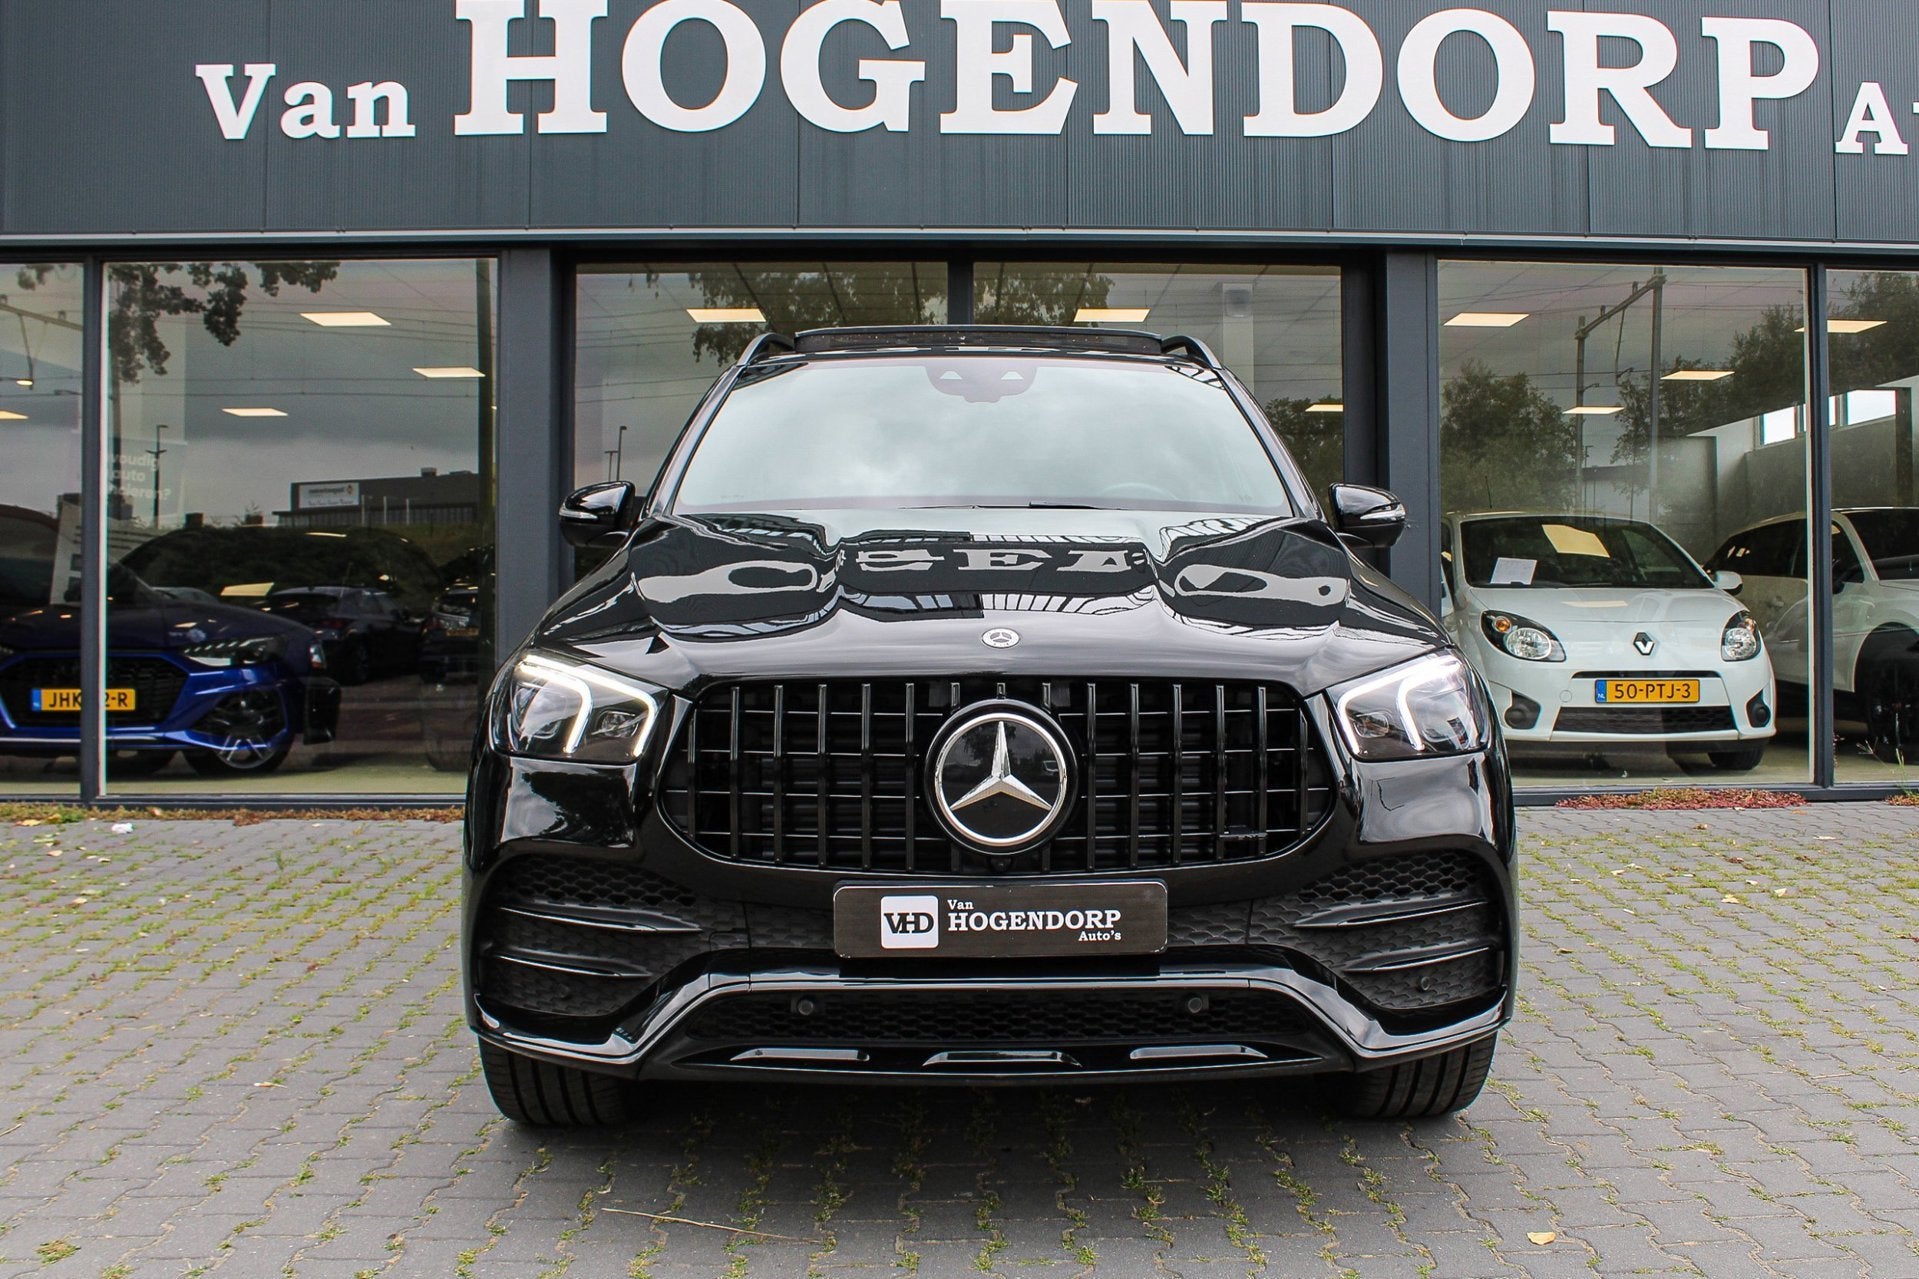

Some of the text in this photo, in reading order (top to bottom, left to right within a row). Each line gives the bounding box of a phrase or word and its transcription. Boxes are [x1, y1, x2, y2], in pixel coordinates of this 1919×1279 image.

[195, 0, 1919, 155] Van HOGENDORP A
[1614, 683, 1691, 699] 50-PTJ-3
[48, 692, 128, 708] JHK2-R
[947, 899, 974, 910] Van
[947, 910, 1122, 932] HOGENDORP
[1078, 930, 1122, 942] Auto's
